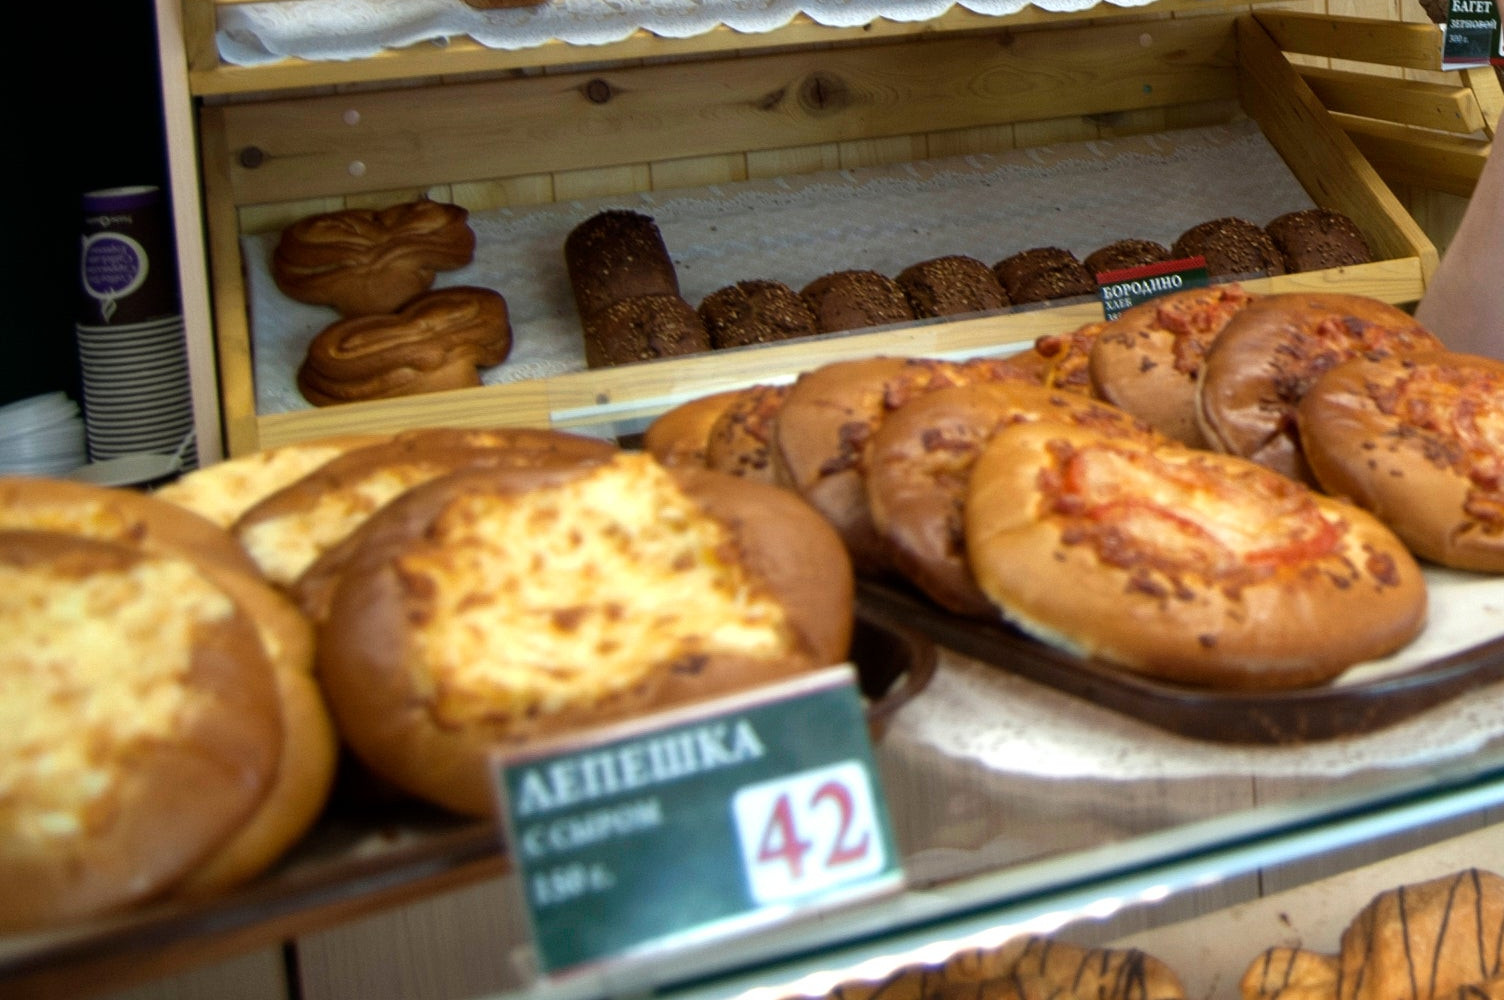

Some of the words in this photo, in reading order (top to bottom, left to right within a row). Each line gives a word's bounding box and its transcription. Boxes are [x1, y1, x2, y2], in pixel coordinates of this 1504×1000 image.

[1452, 0, 1493, 14] БАГЕТ
[1450, 18, 1497, 30] ЗЕРНОВОЙ
[1102, 274, 1183, 300] БОРОДИНО
[1105, 298, 1132, 312] ХЛЕБ
[517, 718, 766, 816] ЛЕПЕШКА
[550, 798, 664, 849] СЫРОМ
[757, 779, 872, 879] 42
